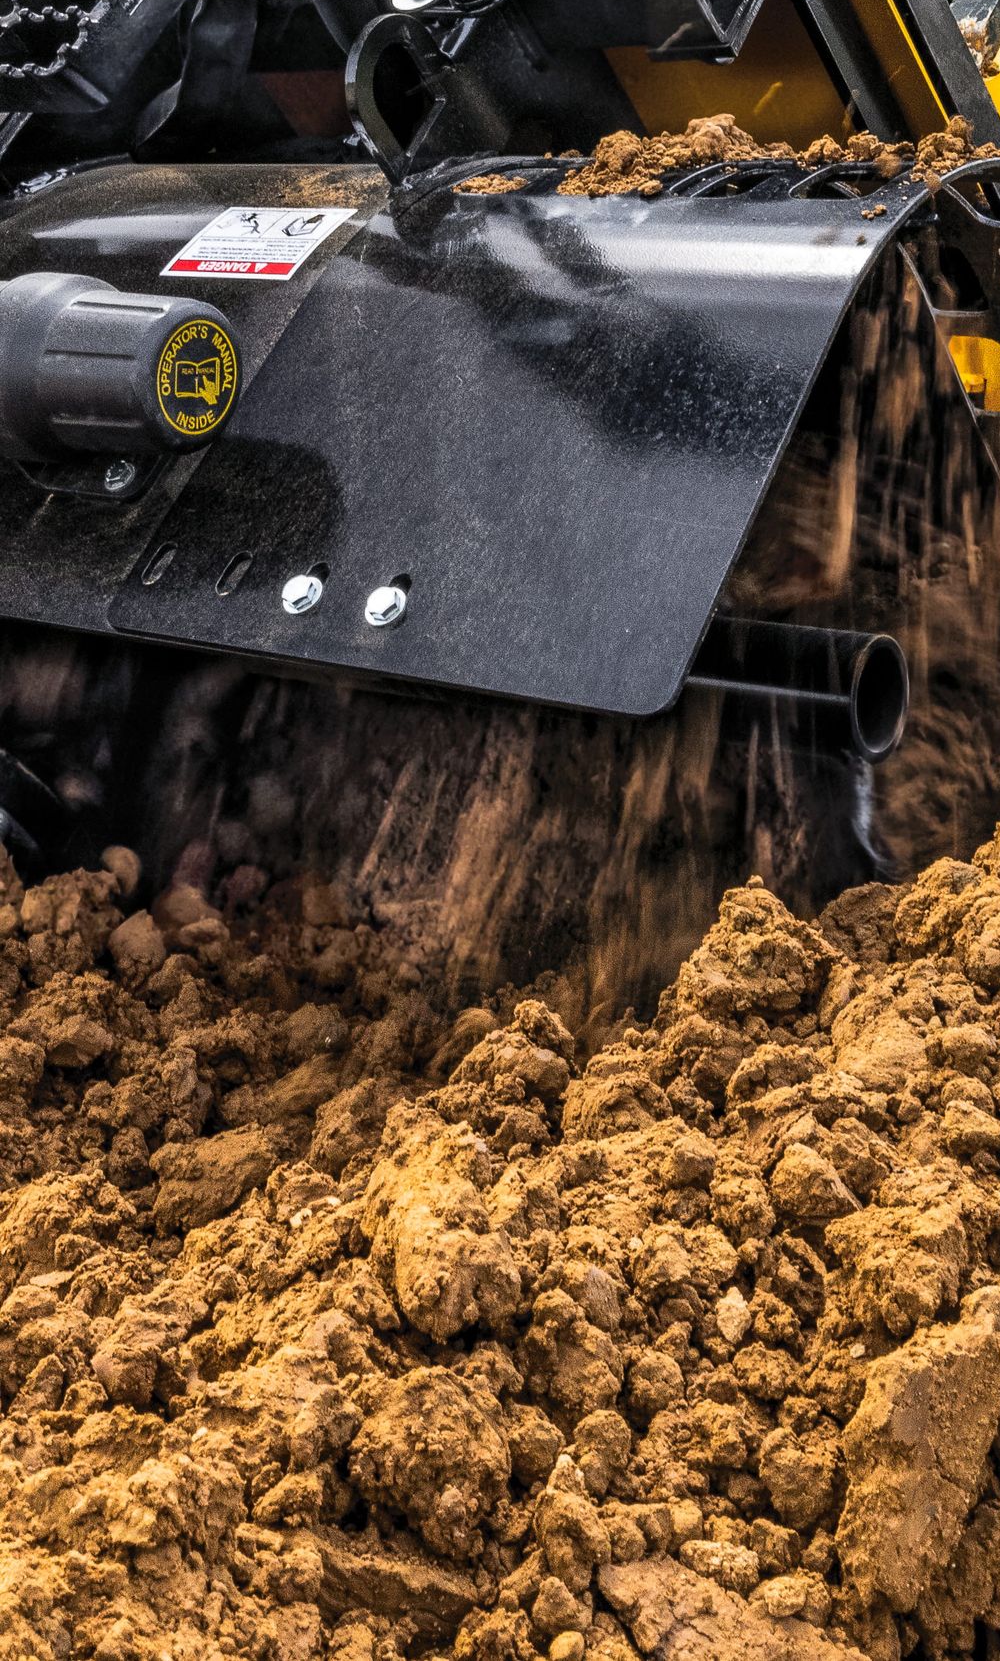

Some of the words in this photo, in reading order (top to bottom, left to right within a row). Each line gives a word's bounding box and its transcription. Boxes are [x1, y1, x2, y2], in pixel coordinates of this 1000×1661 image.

[197, 261, 252, 273] DANGER
[161, 324, 208, 396] OPERATOR'S
[211, 332, 233, 392] MANUAL
[176, 409, 216, 430] INSIDE
